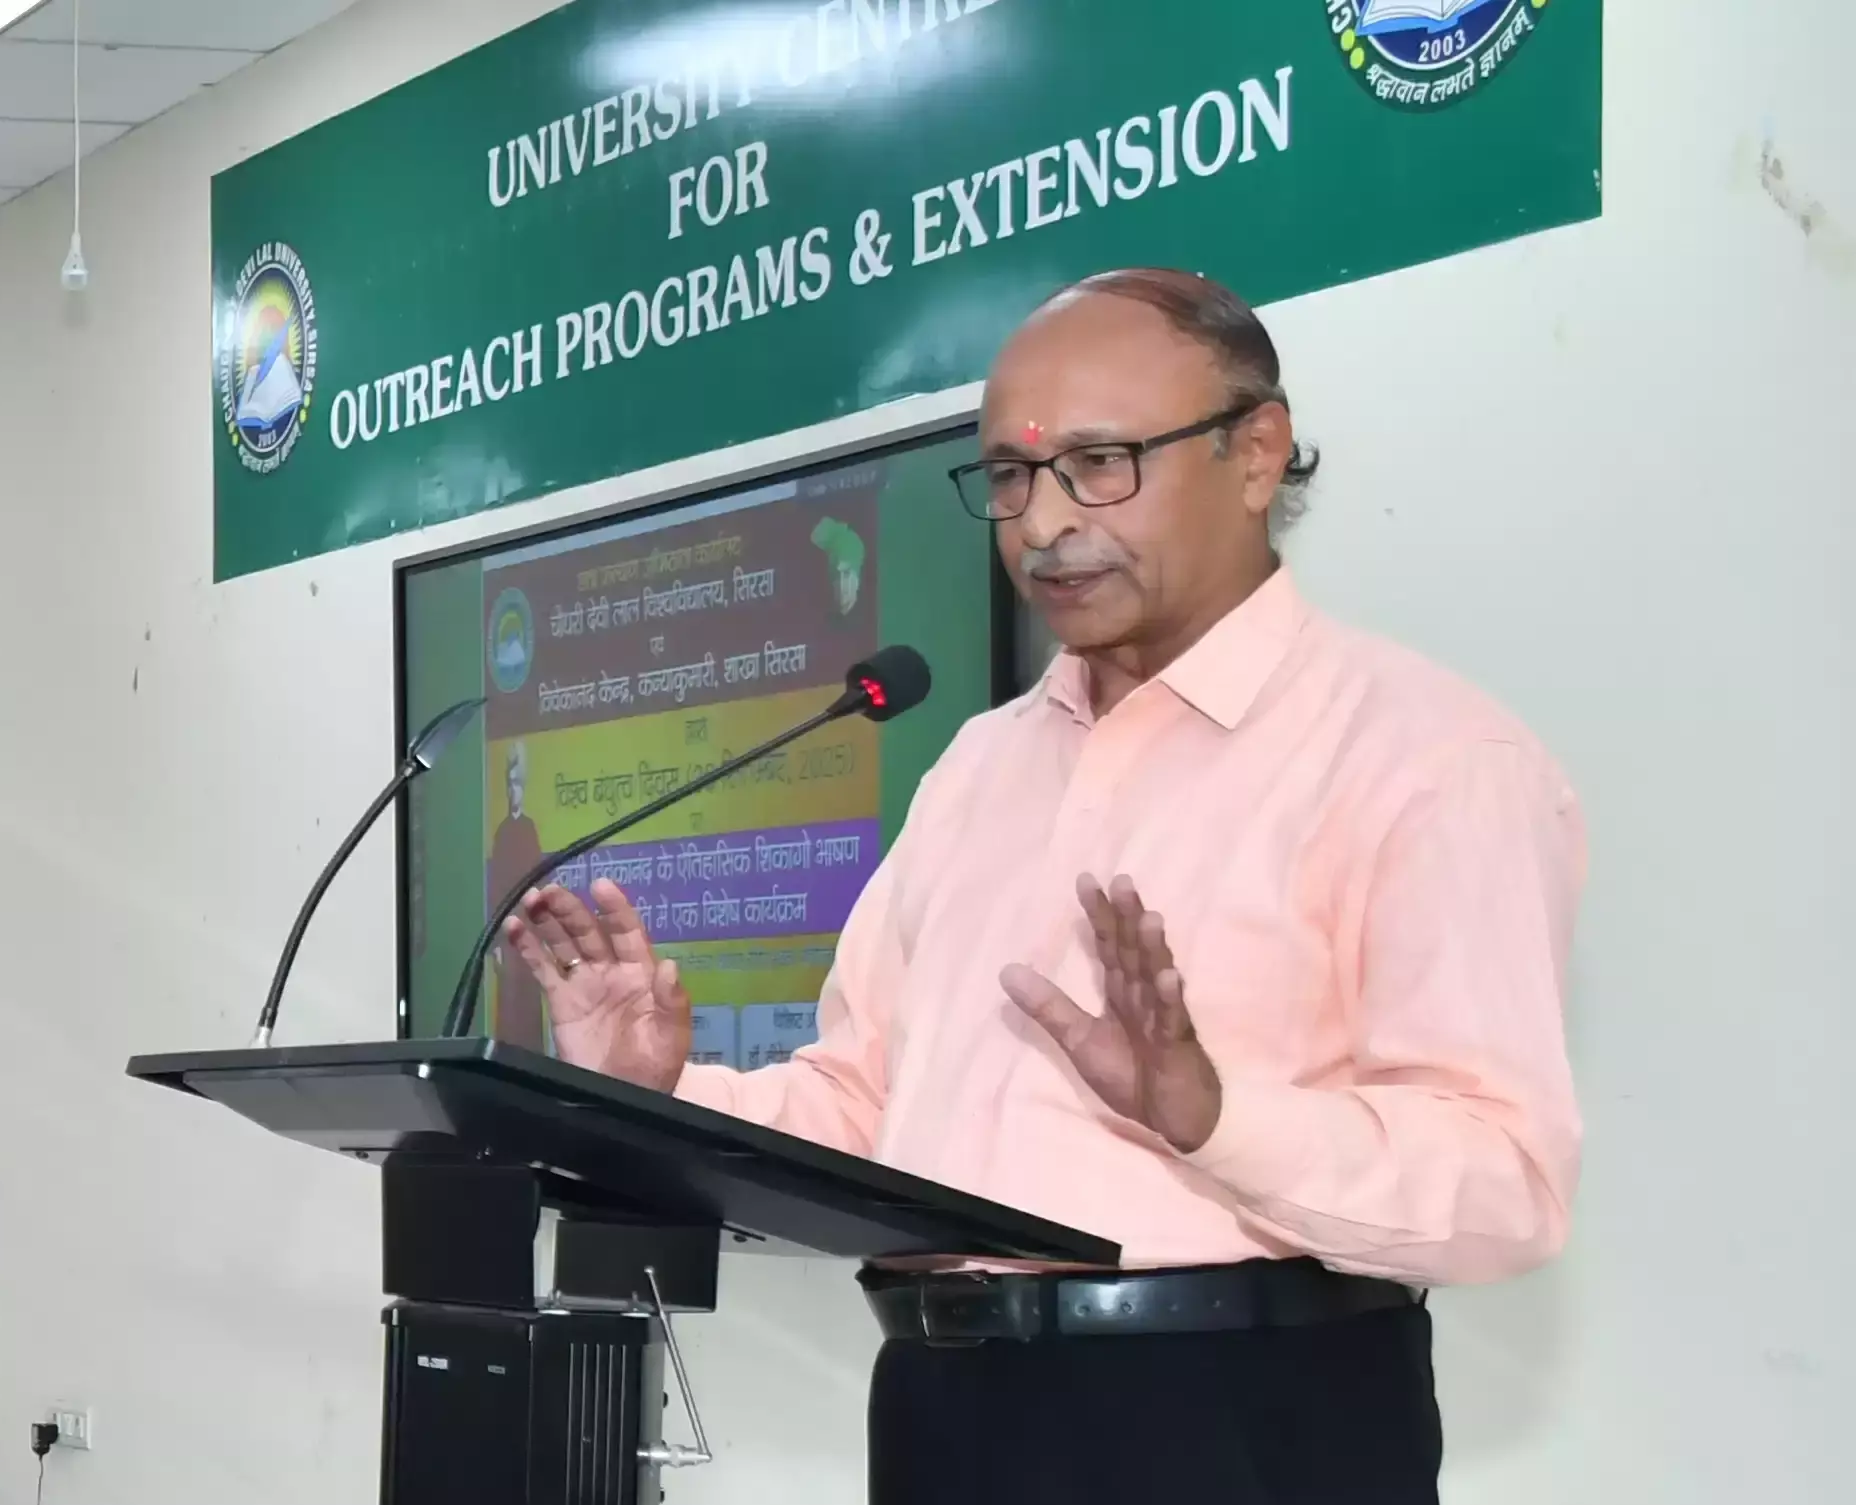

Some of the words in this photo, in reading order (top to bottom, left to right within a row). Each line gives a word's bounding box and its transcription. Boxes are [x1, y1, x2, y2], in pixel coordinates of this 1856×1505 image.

[1418, 29, 1466, 62] 2003
[1430, 57, 1475, 104] लभते
[487, 44, 757, 208] UNIVERSITY
[668, 141, 770, 240] FOR
[256, 243, 273, 266] LAL
[329, 324, 542, 450] OUTREACH
[555, 226, 831, 379] PROGRAMS
[848, 208, 893, 286] &
[911, 66, 1293, 266] EXTENSION
[612, 598, 639, 626] लाल
[733, 566, 774, 602] सिरसा
[724, 652, 760, 683] शाखा
[764, 640, 807, 676] सिरसा
[656, 844, 673, 880] के
[755, 829, 811, 872] शिकागो
[816, 836, 860, 867] भाषण
[672, 902, 698, 936] एक
[702, 888, 740, 928] विशेष
[744, 884, 807, 923] कार्यक्रम
